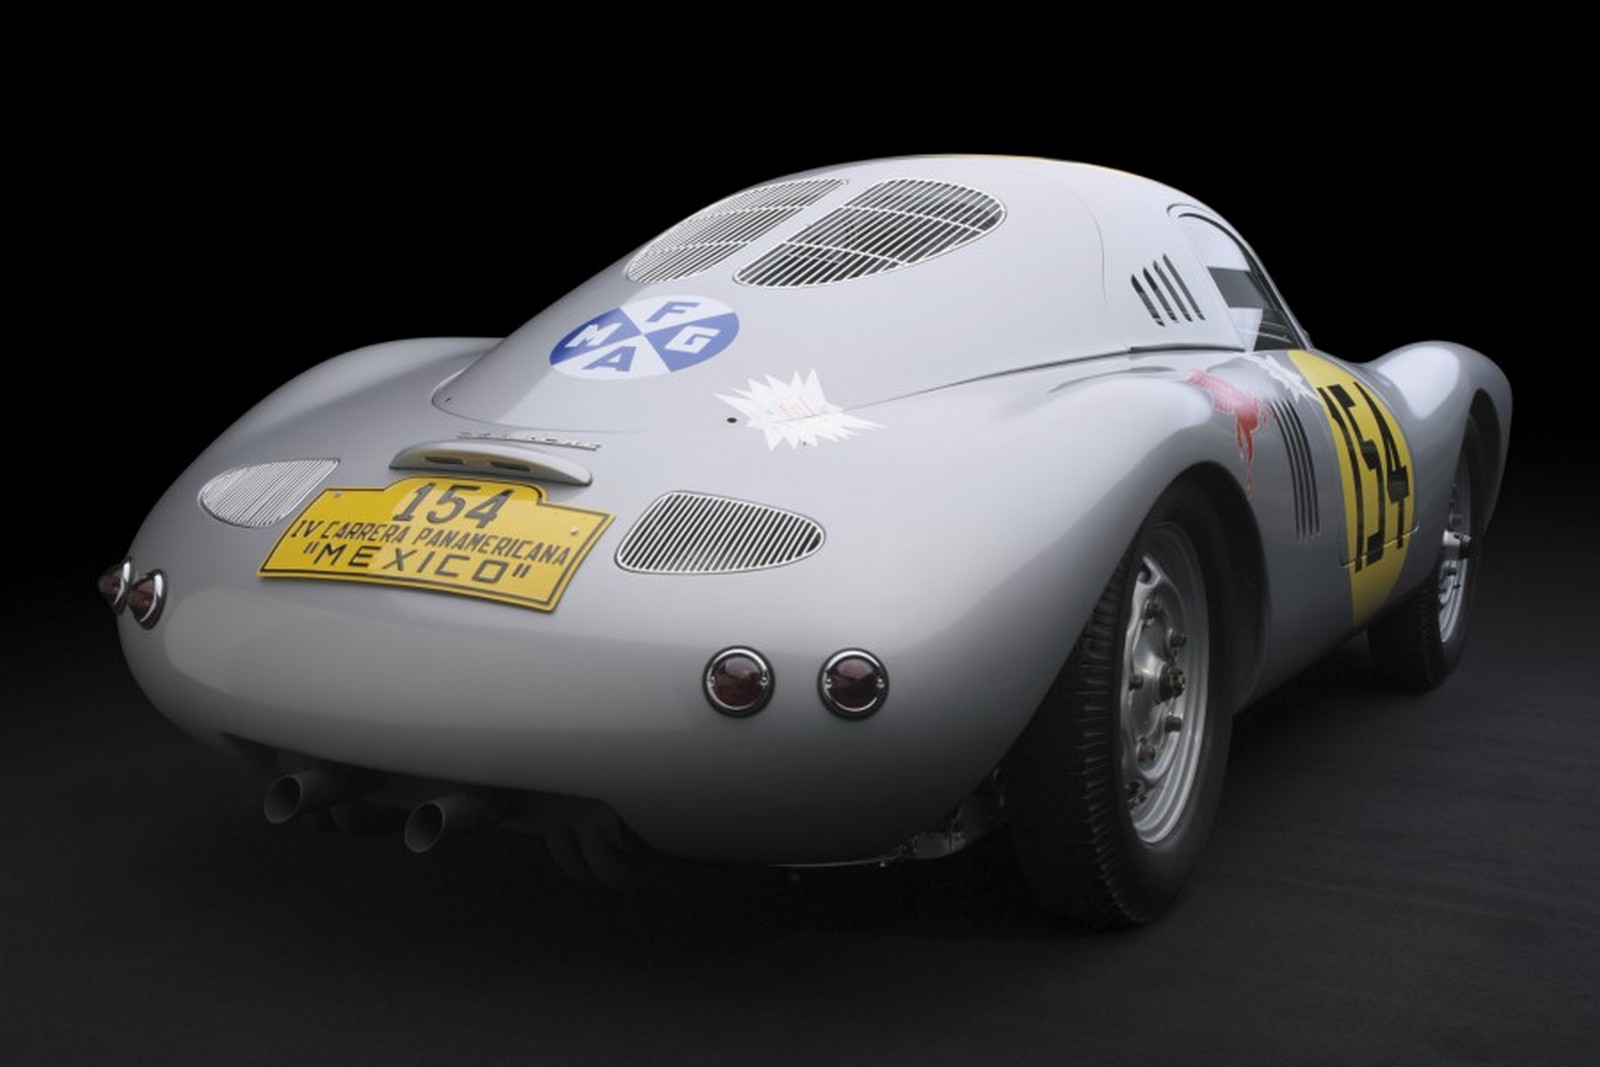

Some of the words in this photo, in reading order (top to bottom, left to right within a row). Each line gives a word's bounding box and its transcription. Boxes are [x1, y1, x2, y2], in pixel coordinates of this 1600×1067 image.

[646, 301, 701, 323] F
[564, 322, 624, 348] M
[664, 325, 721, 354] G
[581, 346, 637, 372] A
[1316, 381, 1410, 573] 154
[392, 482, 516, 529] 154
[291, 520, 324, 539] IV
[320, 520, 406, 544] CARRERA
[413, 527, 571, 566] PANAMERICANA
[302, 542, 532, 584] "MEXICO"
